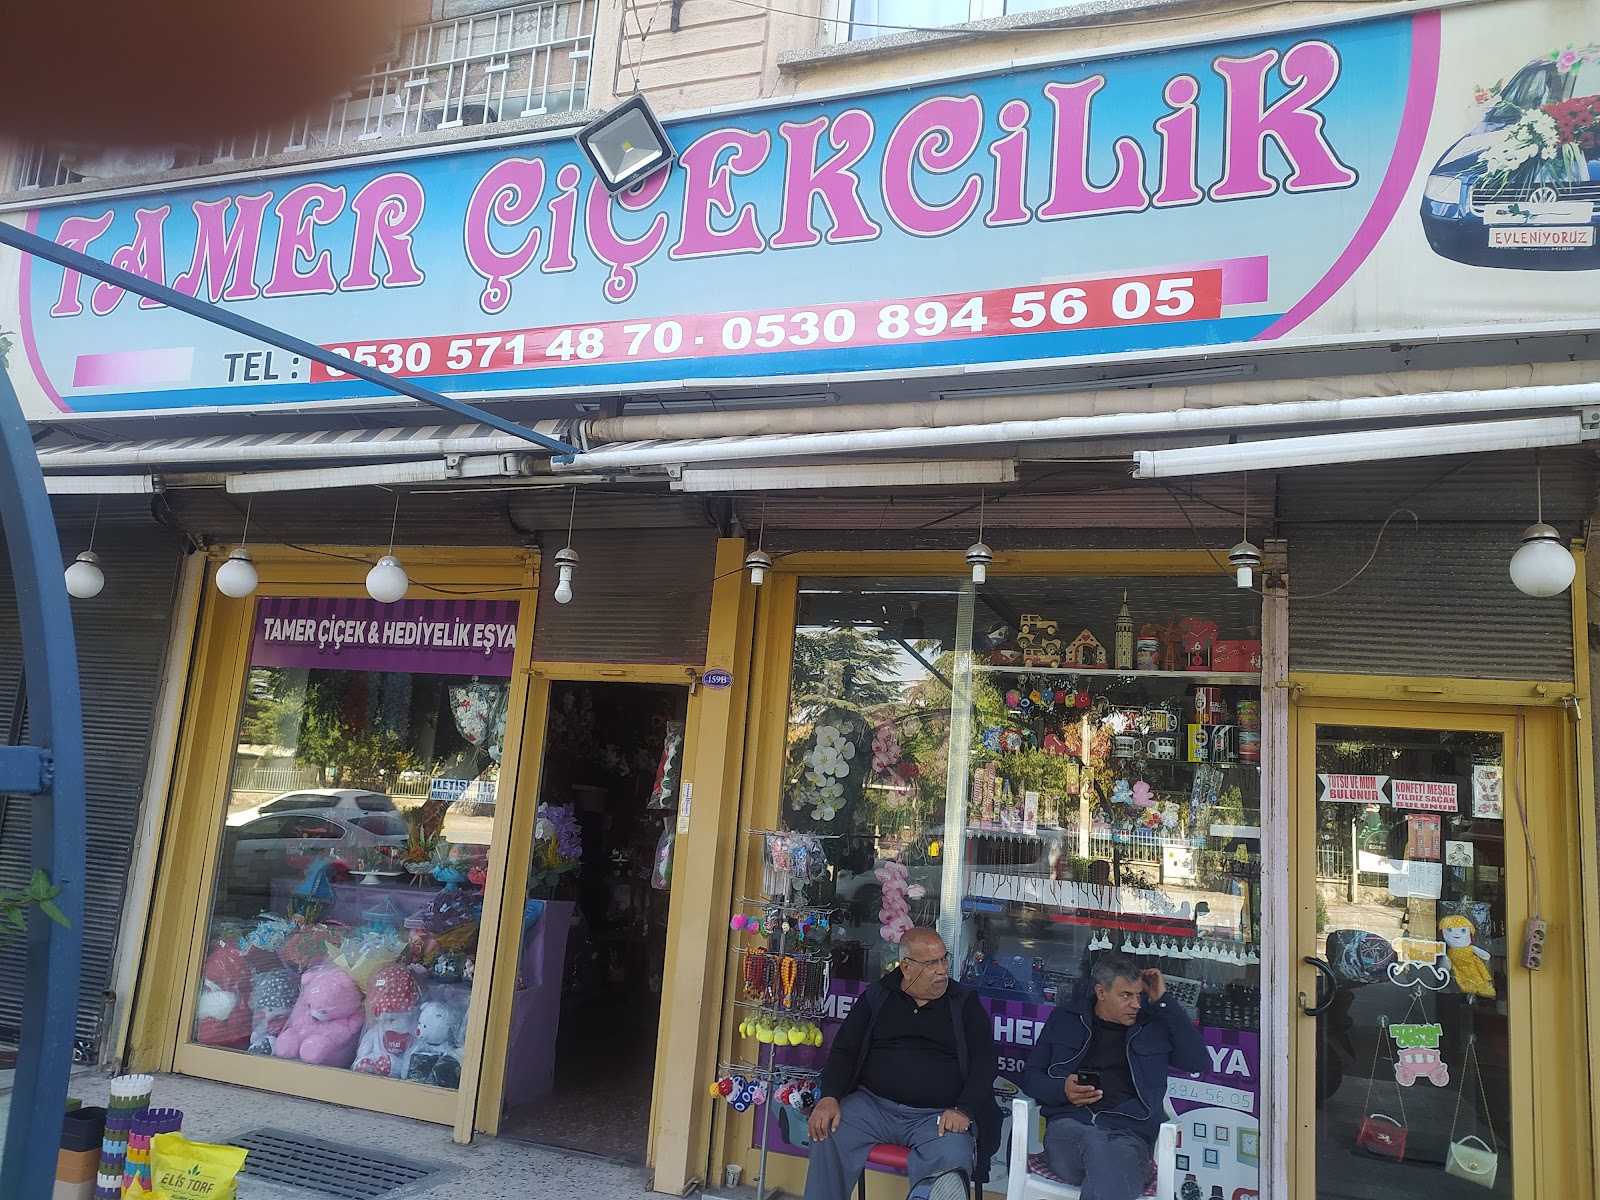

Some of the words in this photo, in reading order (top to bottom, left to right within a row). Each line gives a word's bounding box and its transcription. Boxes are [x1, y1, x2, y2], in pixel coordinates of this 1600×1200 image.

[50, 172, 425, 318] TAMER
[1495, 229, 1588, 245] EVLENİYORUZ
[446, 334, 525, 371] 571
[545, 327, 604, 361] 48
[623, 320, 684, 356] 70
[720, 308, 857, 351] 0530
[876, 295, 989, 340] 894
[1010, 287, 1088, 328] 56
[1111, 277, 1195, 320] 05
[264, 618, 315, 641] TAMER
[317, 613, 367, 649] ÇİÇEK
[367, 621, 380, 643] &
[382, 615, 472, 647] HEDİYELİK
[472, 624, 516, 654] EŞYA
[707, 675, 727, 684] 159B
[1327, 775, 1349, 789] TUTSU
[1350, 776, 1359, 789] VE
[1359, 776, 1377, 790] MUM
[1329, 789, 1379, 801] BULUNUR
[1169, 1082, 1198, 1099] 894
[1205, 1088, 1224, 1104] 56
[1230, 1093, 1251, 1108] 05
